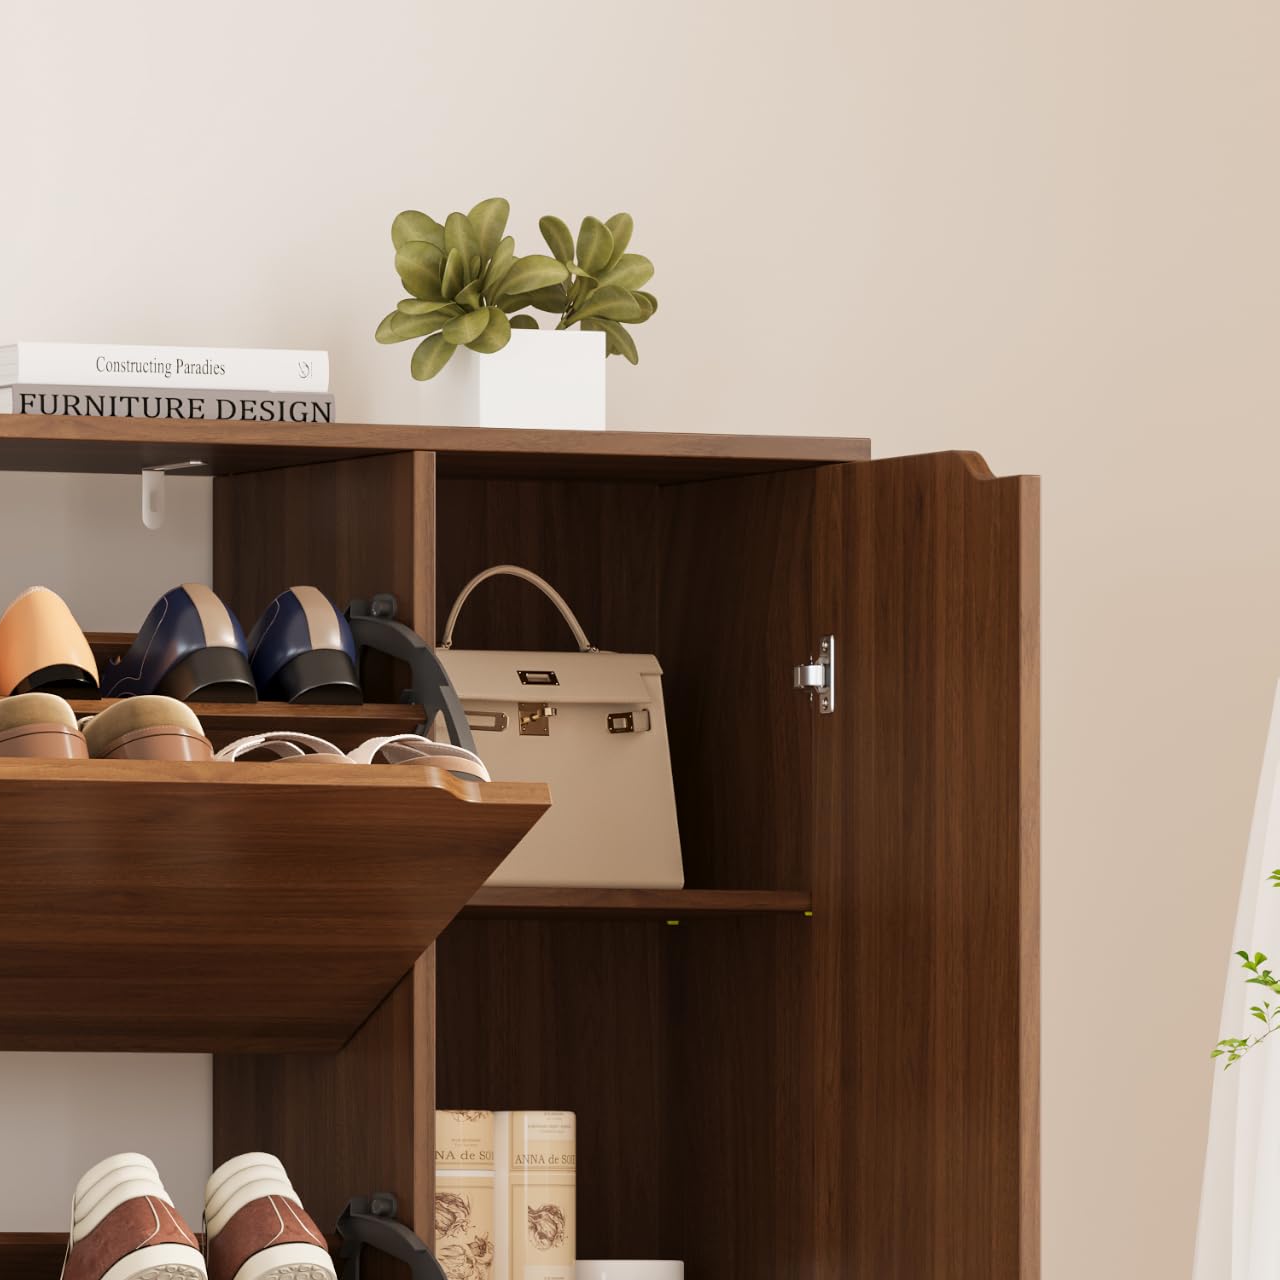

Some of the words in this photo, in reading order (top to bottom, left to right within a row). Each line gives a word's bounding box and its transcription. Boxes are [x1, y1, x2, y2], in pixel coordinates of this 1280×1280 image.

[96, 356, 173, 378] Constructing
[175, 358, 226, 376] Paradies
[19, 393, 205, 420] FURNITURE
[216, 398, 333, 424] DESIGN
[460, 1150, 476, 1160] de
[515, 1153, 545, 1165] ANNA
[548, 1153, 559, 1165] de
